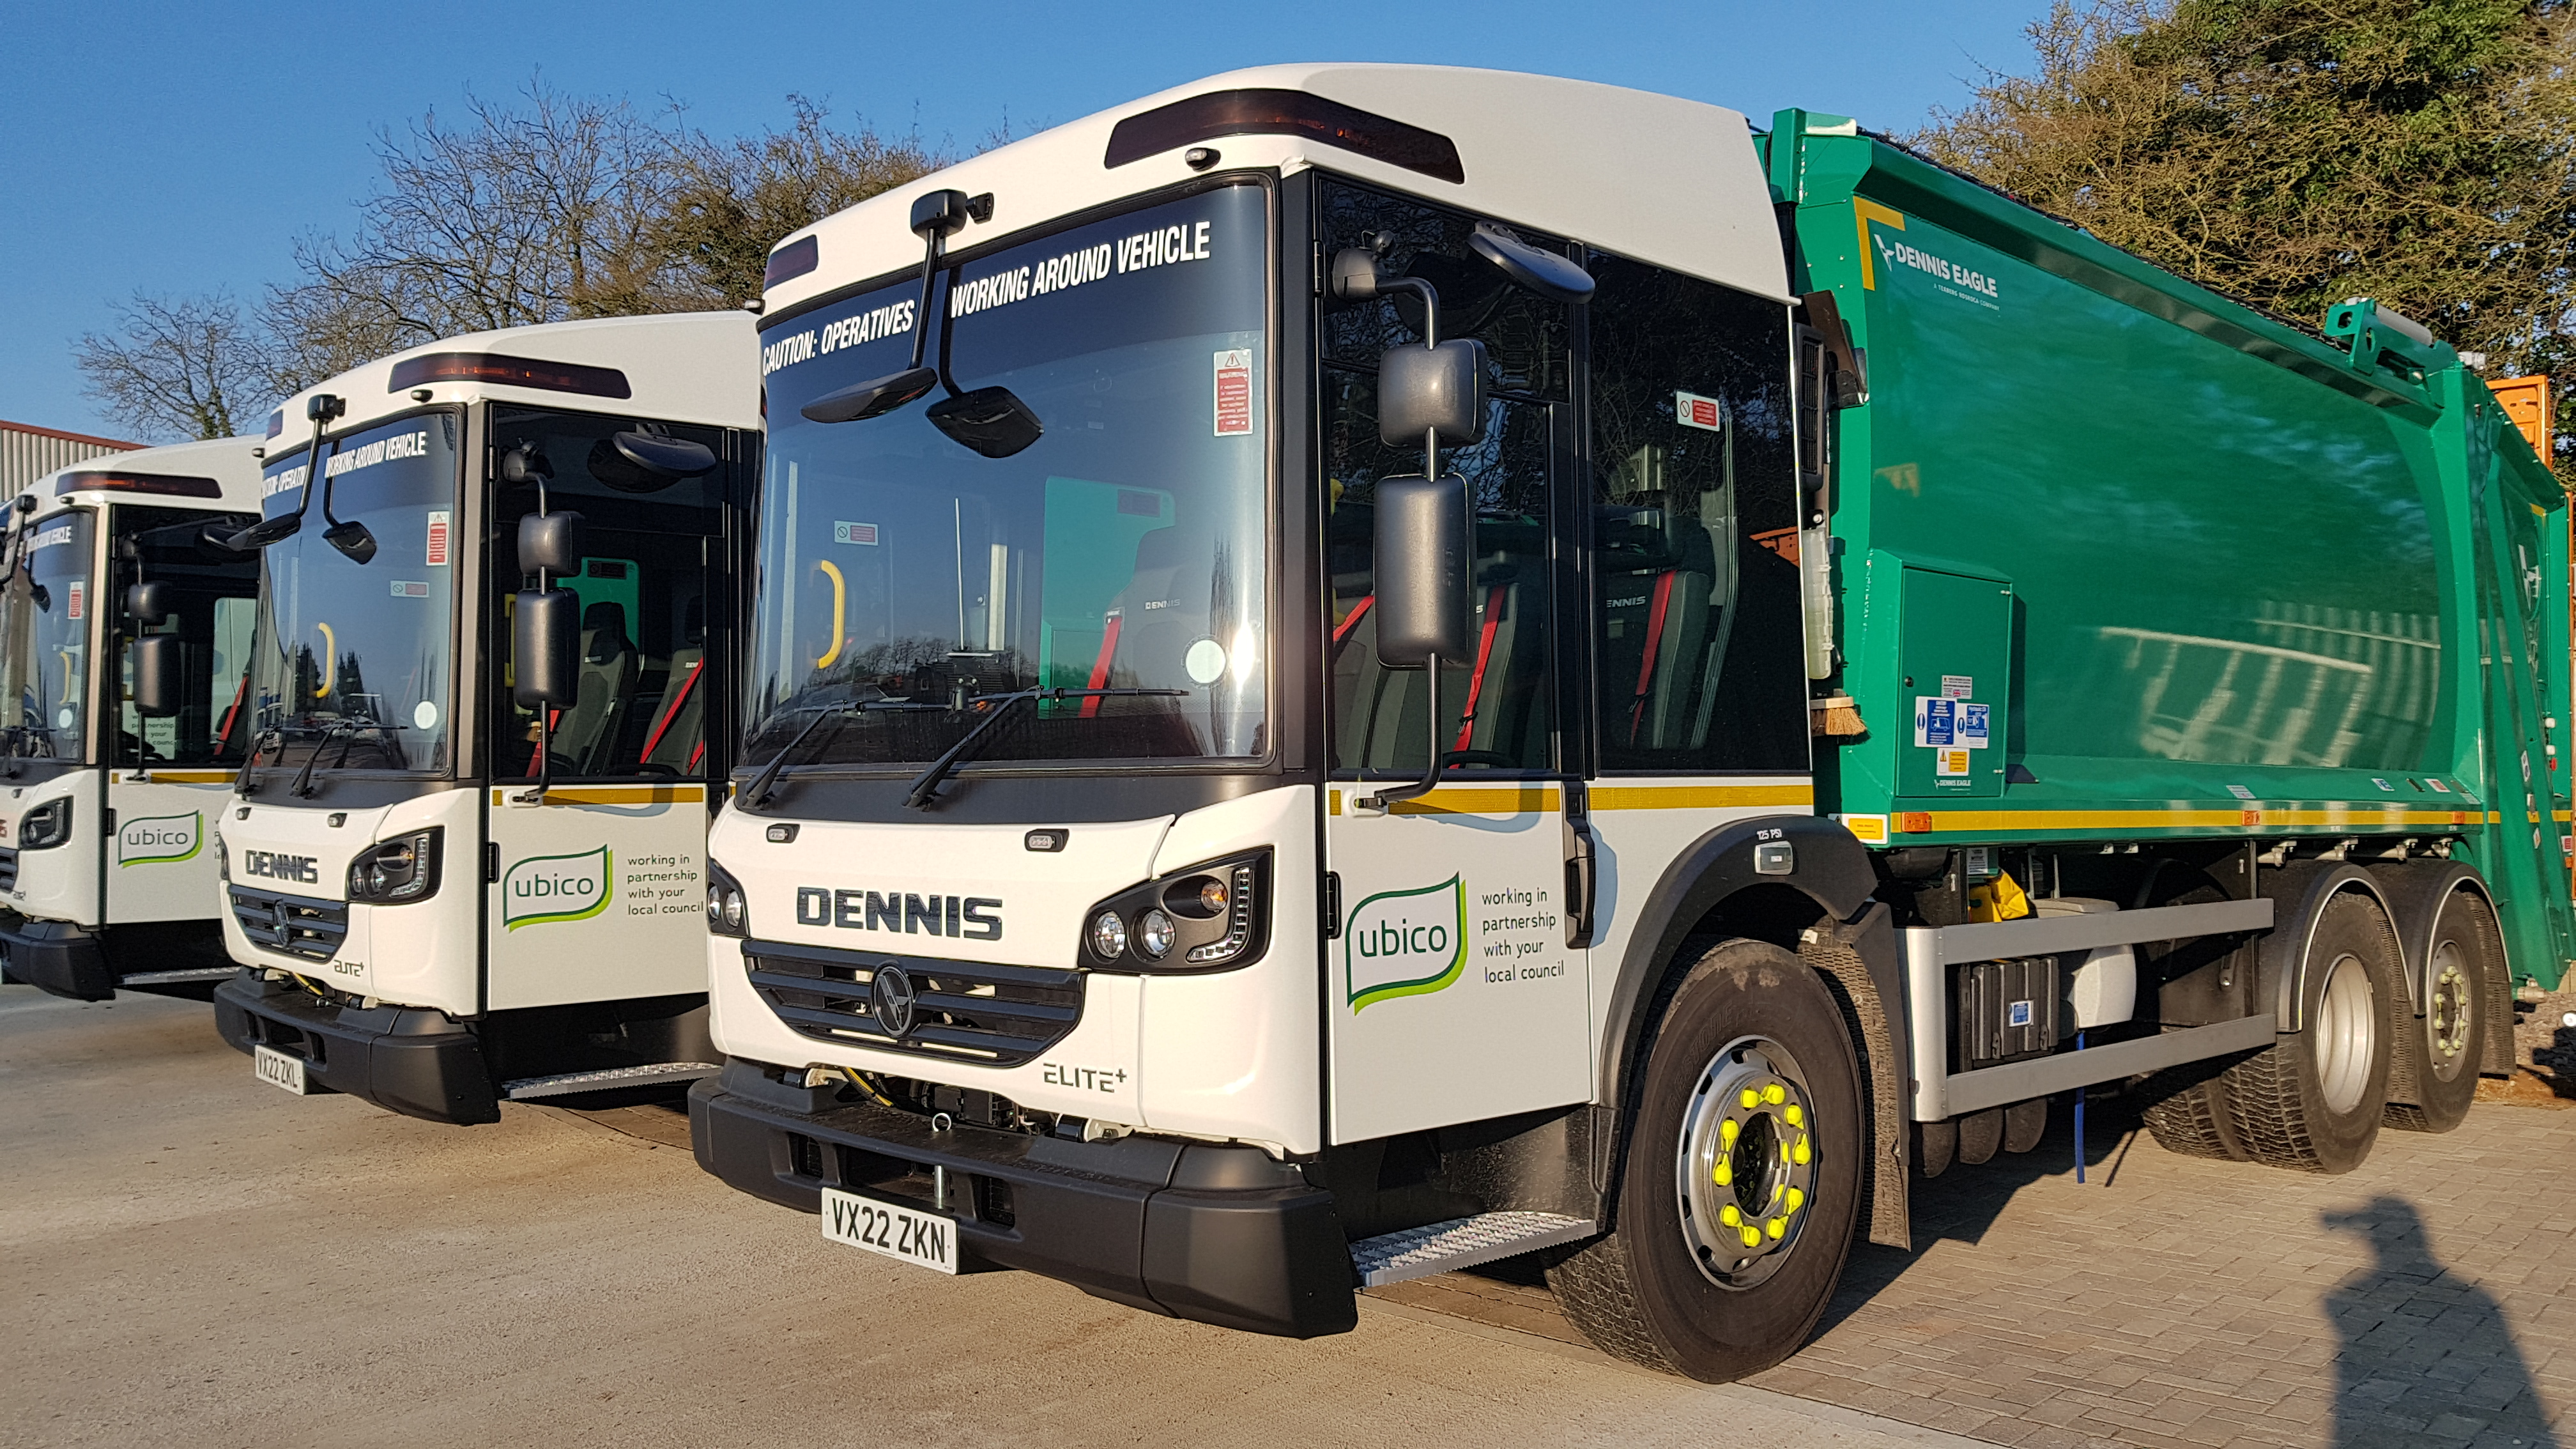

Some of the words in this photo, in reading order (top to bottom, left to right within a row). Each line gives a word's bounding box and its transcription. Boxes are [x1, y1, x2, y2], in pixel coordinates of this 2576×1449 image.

[1895, 242, 1951, 280] DENNIS
[1952, 264, 1998, 298] EAGLE
[763, 330, 817, 376] CAUTION:
[821, 300, 915, 355] OPERATIVES
[951, 266, 1030, 318] WORKING
[1031, 243, 1111, 296] AROUND
[1117, 221, 1210, 273] VEHICLE
[385, 431, 426, 461] VEHICLE
[1146, 599, 1180, 610] DENNIS
[1606, 596, 1646, 608] ENNIS
[128, 829, 188, 845] ubico
[1756, 830, 1769, 840] 125
[1770, 829, 1782, 838] PSI
[245, 849, 318, 884] DENNIS
[627, 854, 675, 867] working
[680, 854, 690, 864] in
[515, 873, 594, 897] ubico
[627, 869, 697, 885] partnership
[628, 887, 654, 898] with
[659, 889, 685, 900] your
[1482, 887, 1532, 906] working
[1537, 887, 1547, 902] in
[628, 903, 657, 915] local
[662, 901, 703, 914] council
[797, 887, 1002, 940] DENNIS
[1483, 910, 1556, 935] partnership
[1360, 918, 1447, 957] ubico
[1483, 939, 1512, 957] with
[1517, 942, 1544, 959] your
[1485, 963, 1516, 983] local
[1521, 960, 1564, 979] council
[257, 1050, 279, 1081] VX22
[281, 1060, 298, 1089] ZKL
[1043, 1062, 1127, 1092] ELITE+
[832, 1197, 890, 1248] VX22
[898, 1215, 945, 1263] ZKN
